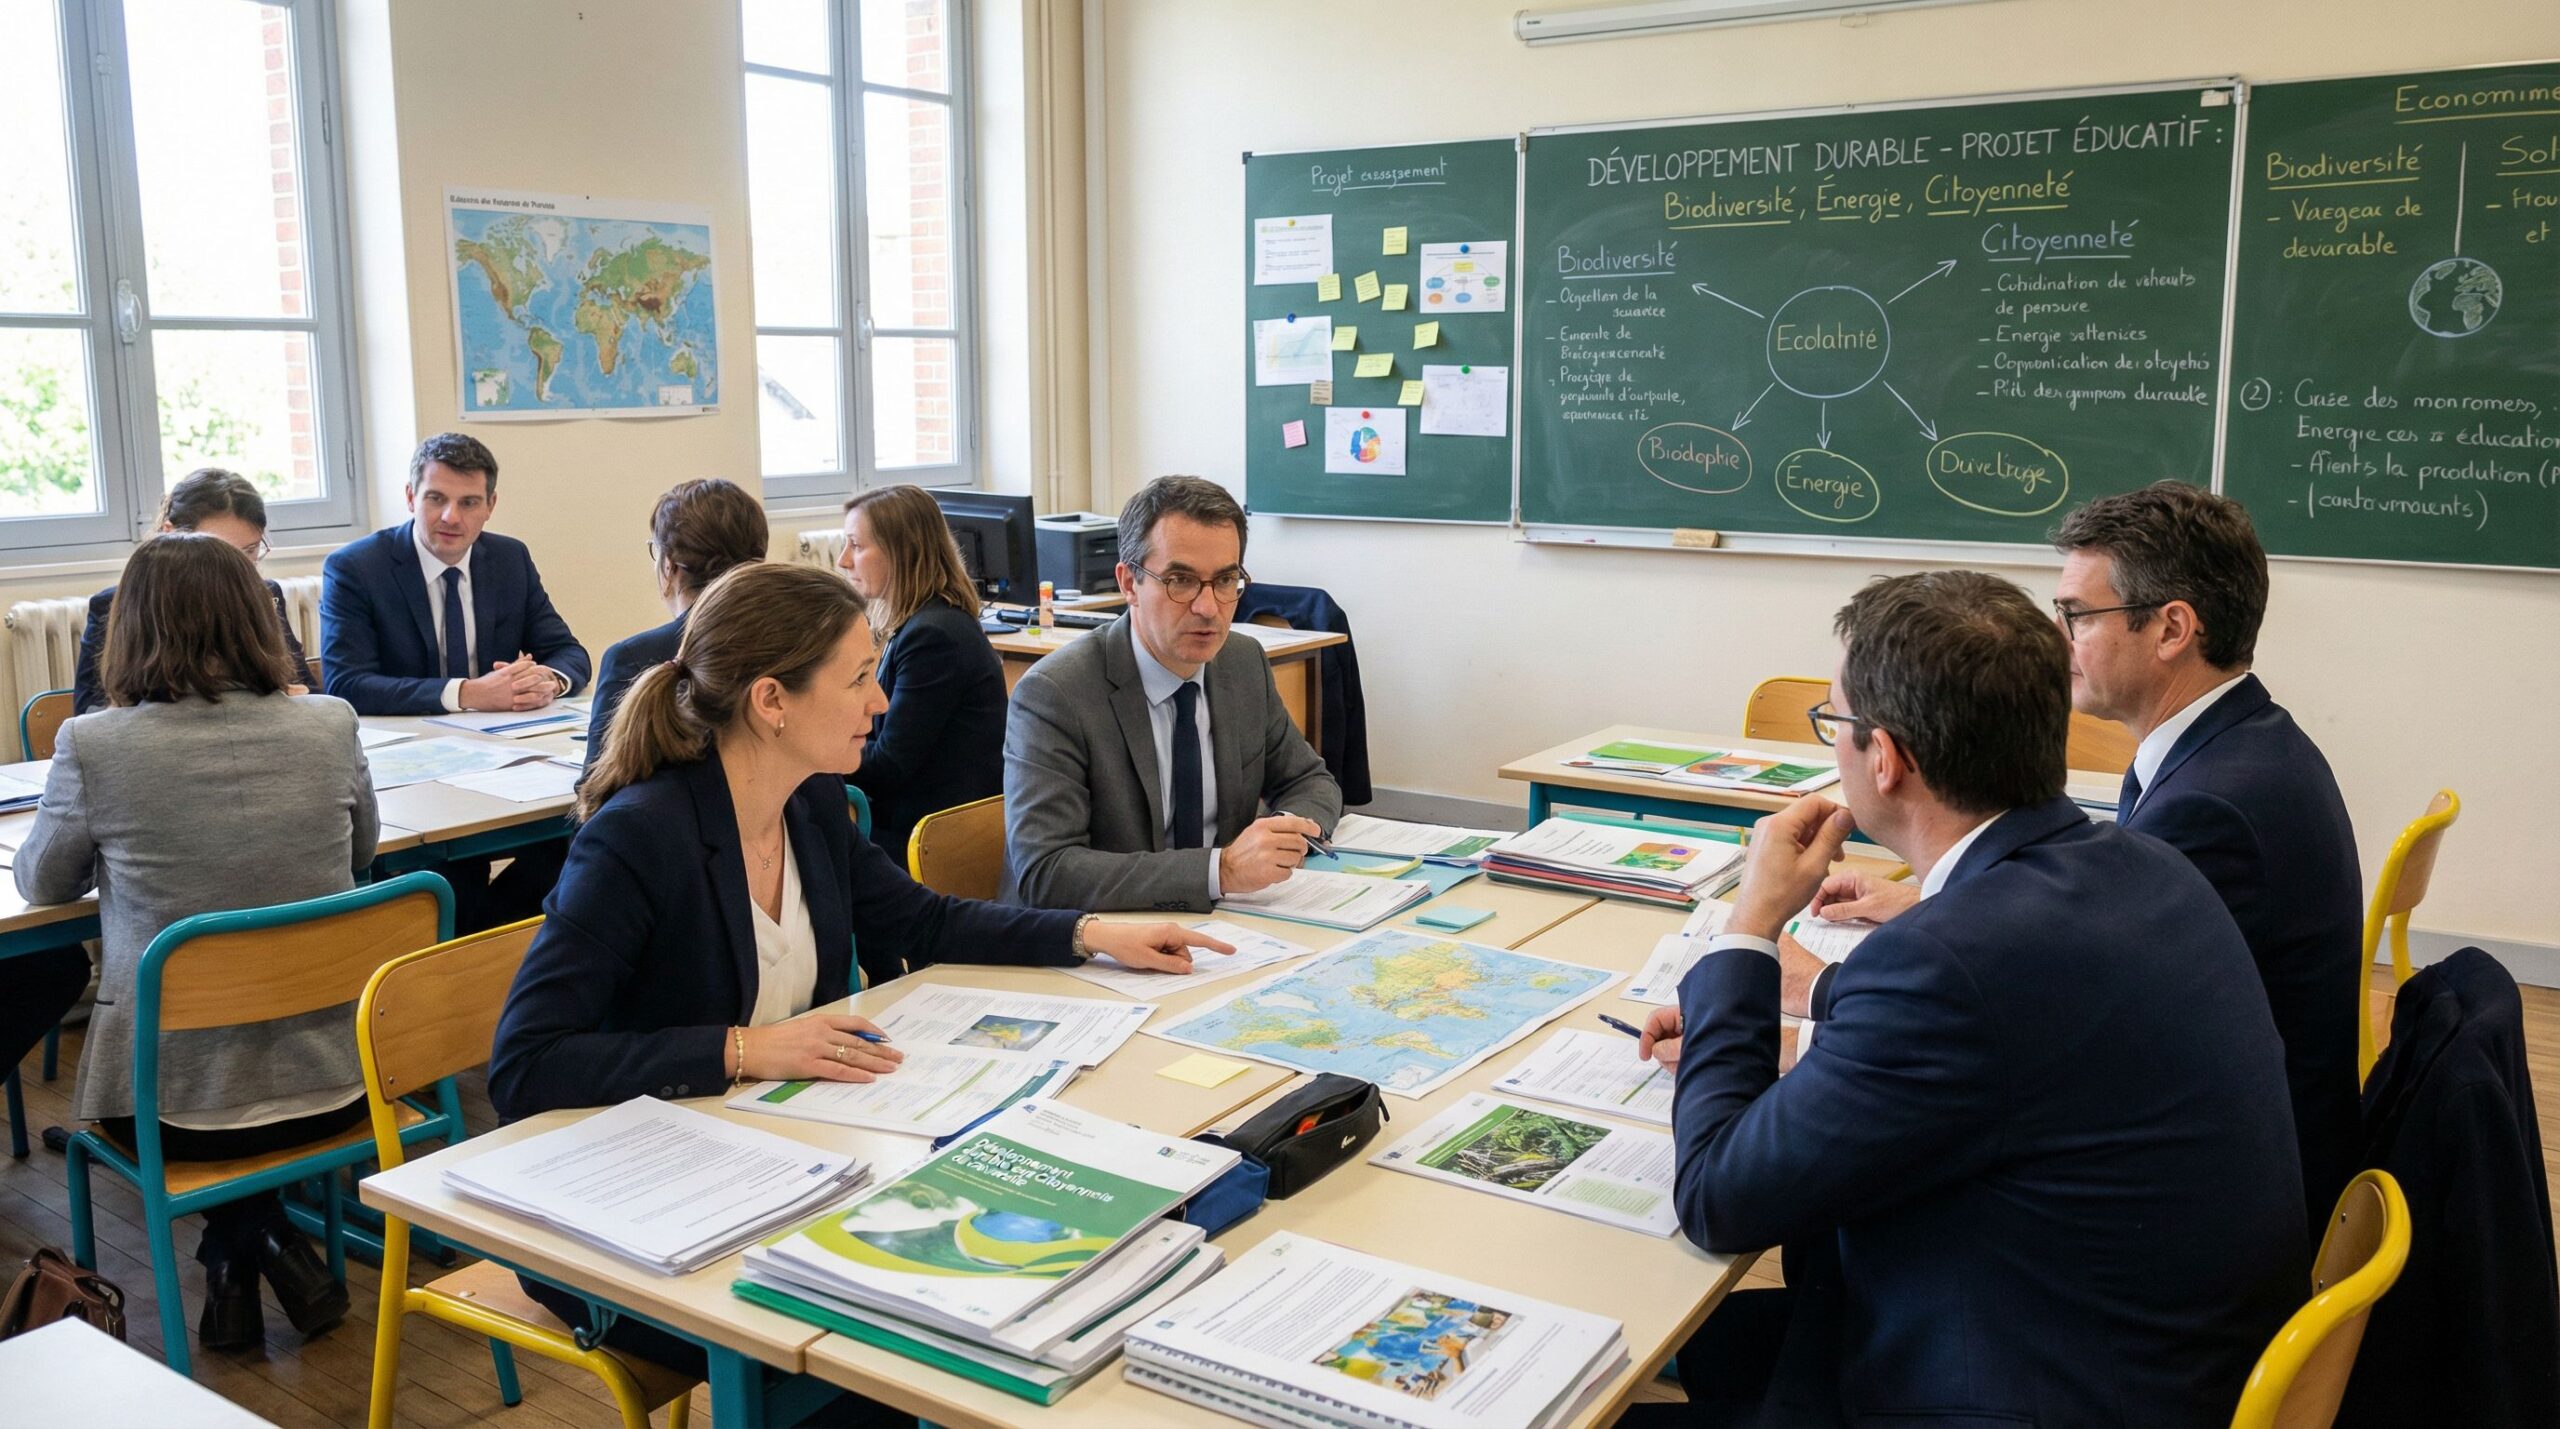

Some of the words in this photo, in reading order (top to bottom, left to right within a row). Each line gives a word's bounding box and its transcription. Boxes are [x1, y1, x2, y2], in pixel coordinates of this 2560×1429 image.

[1587, 144, 1801, 187] DÉVELOPPEMENT
[1814, 135, 1932, 172] DURABLE
[1961, 128, 2062, 160] PROJET
[2072, 114, 2210, 153] ÉDUCATIF
[2266, 143, 2424, 182] Biodiversité
[1311, 164, 1353, 197] Projet
[1664, 185, 1806, 221] Biodiversité,
[1925, 169, 2075, 217] Citoyenneté
[2395, 195, 2423, 216] de
[1558, 240, 1678, 273] Biodiversité
[1981, 219, 2140, 264] Citoyenneté
[1622, 285, 1639, 300] de
[2107, 270, 2128, 288] de
[1995, 298, 2015, 315] de
[1615, 324, 1633, 340] de
[2386, 451, 2409, 477] la
[1786, 454, 1865, 510] Énergie
